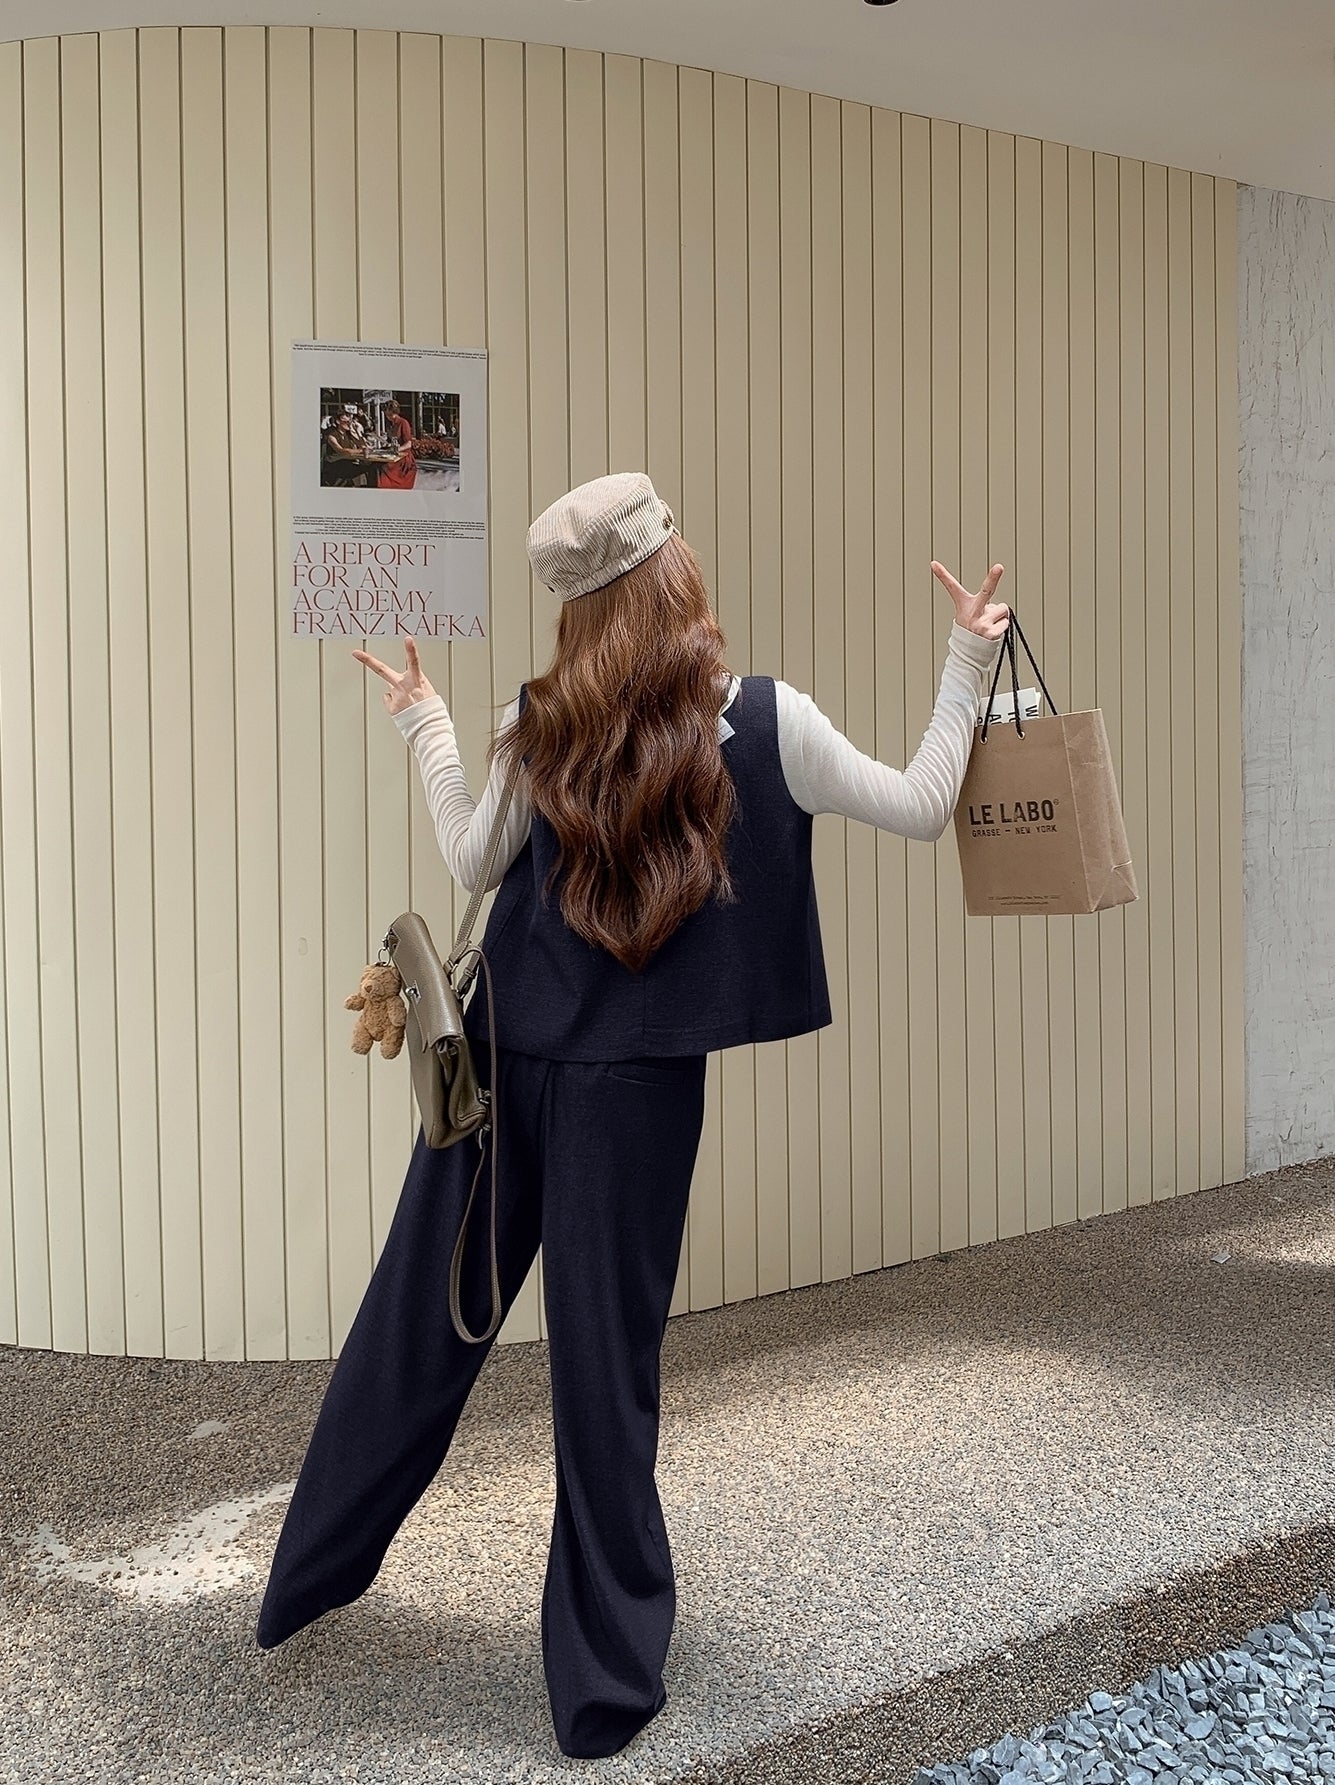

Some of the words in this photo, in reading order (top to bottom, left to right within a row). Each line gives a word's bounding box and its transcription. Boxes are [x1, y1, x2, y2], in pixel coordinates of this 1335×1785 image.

[293, 542, 312, 564] A
[322, 542, 436, 566] REPORT
[293, 565, 350, 587] FOR
[360, 567, 399, 589] AN
[293, 588, 433, 613] ACADEMY
[293, 612, 386, 635] FRANZ
[394, 613, 486, 638] KAFKA
[969, 804, 995, 825] LE
[972, 828, 1001, 838] GRASSE
[1015, 826, 1031, 834] NEW
[1035, 824, 1058, 833] YORK
